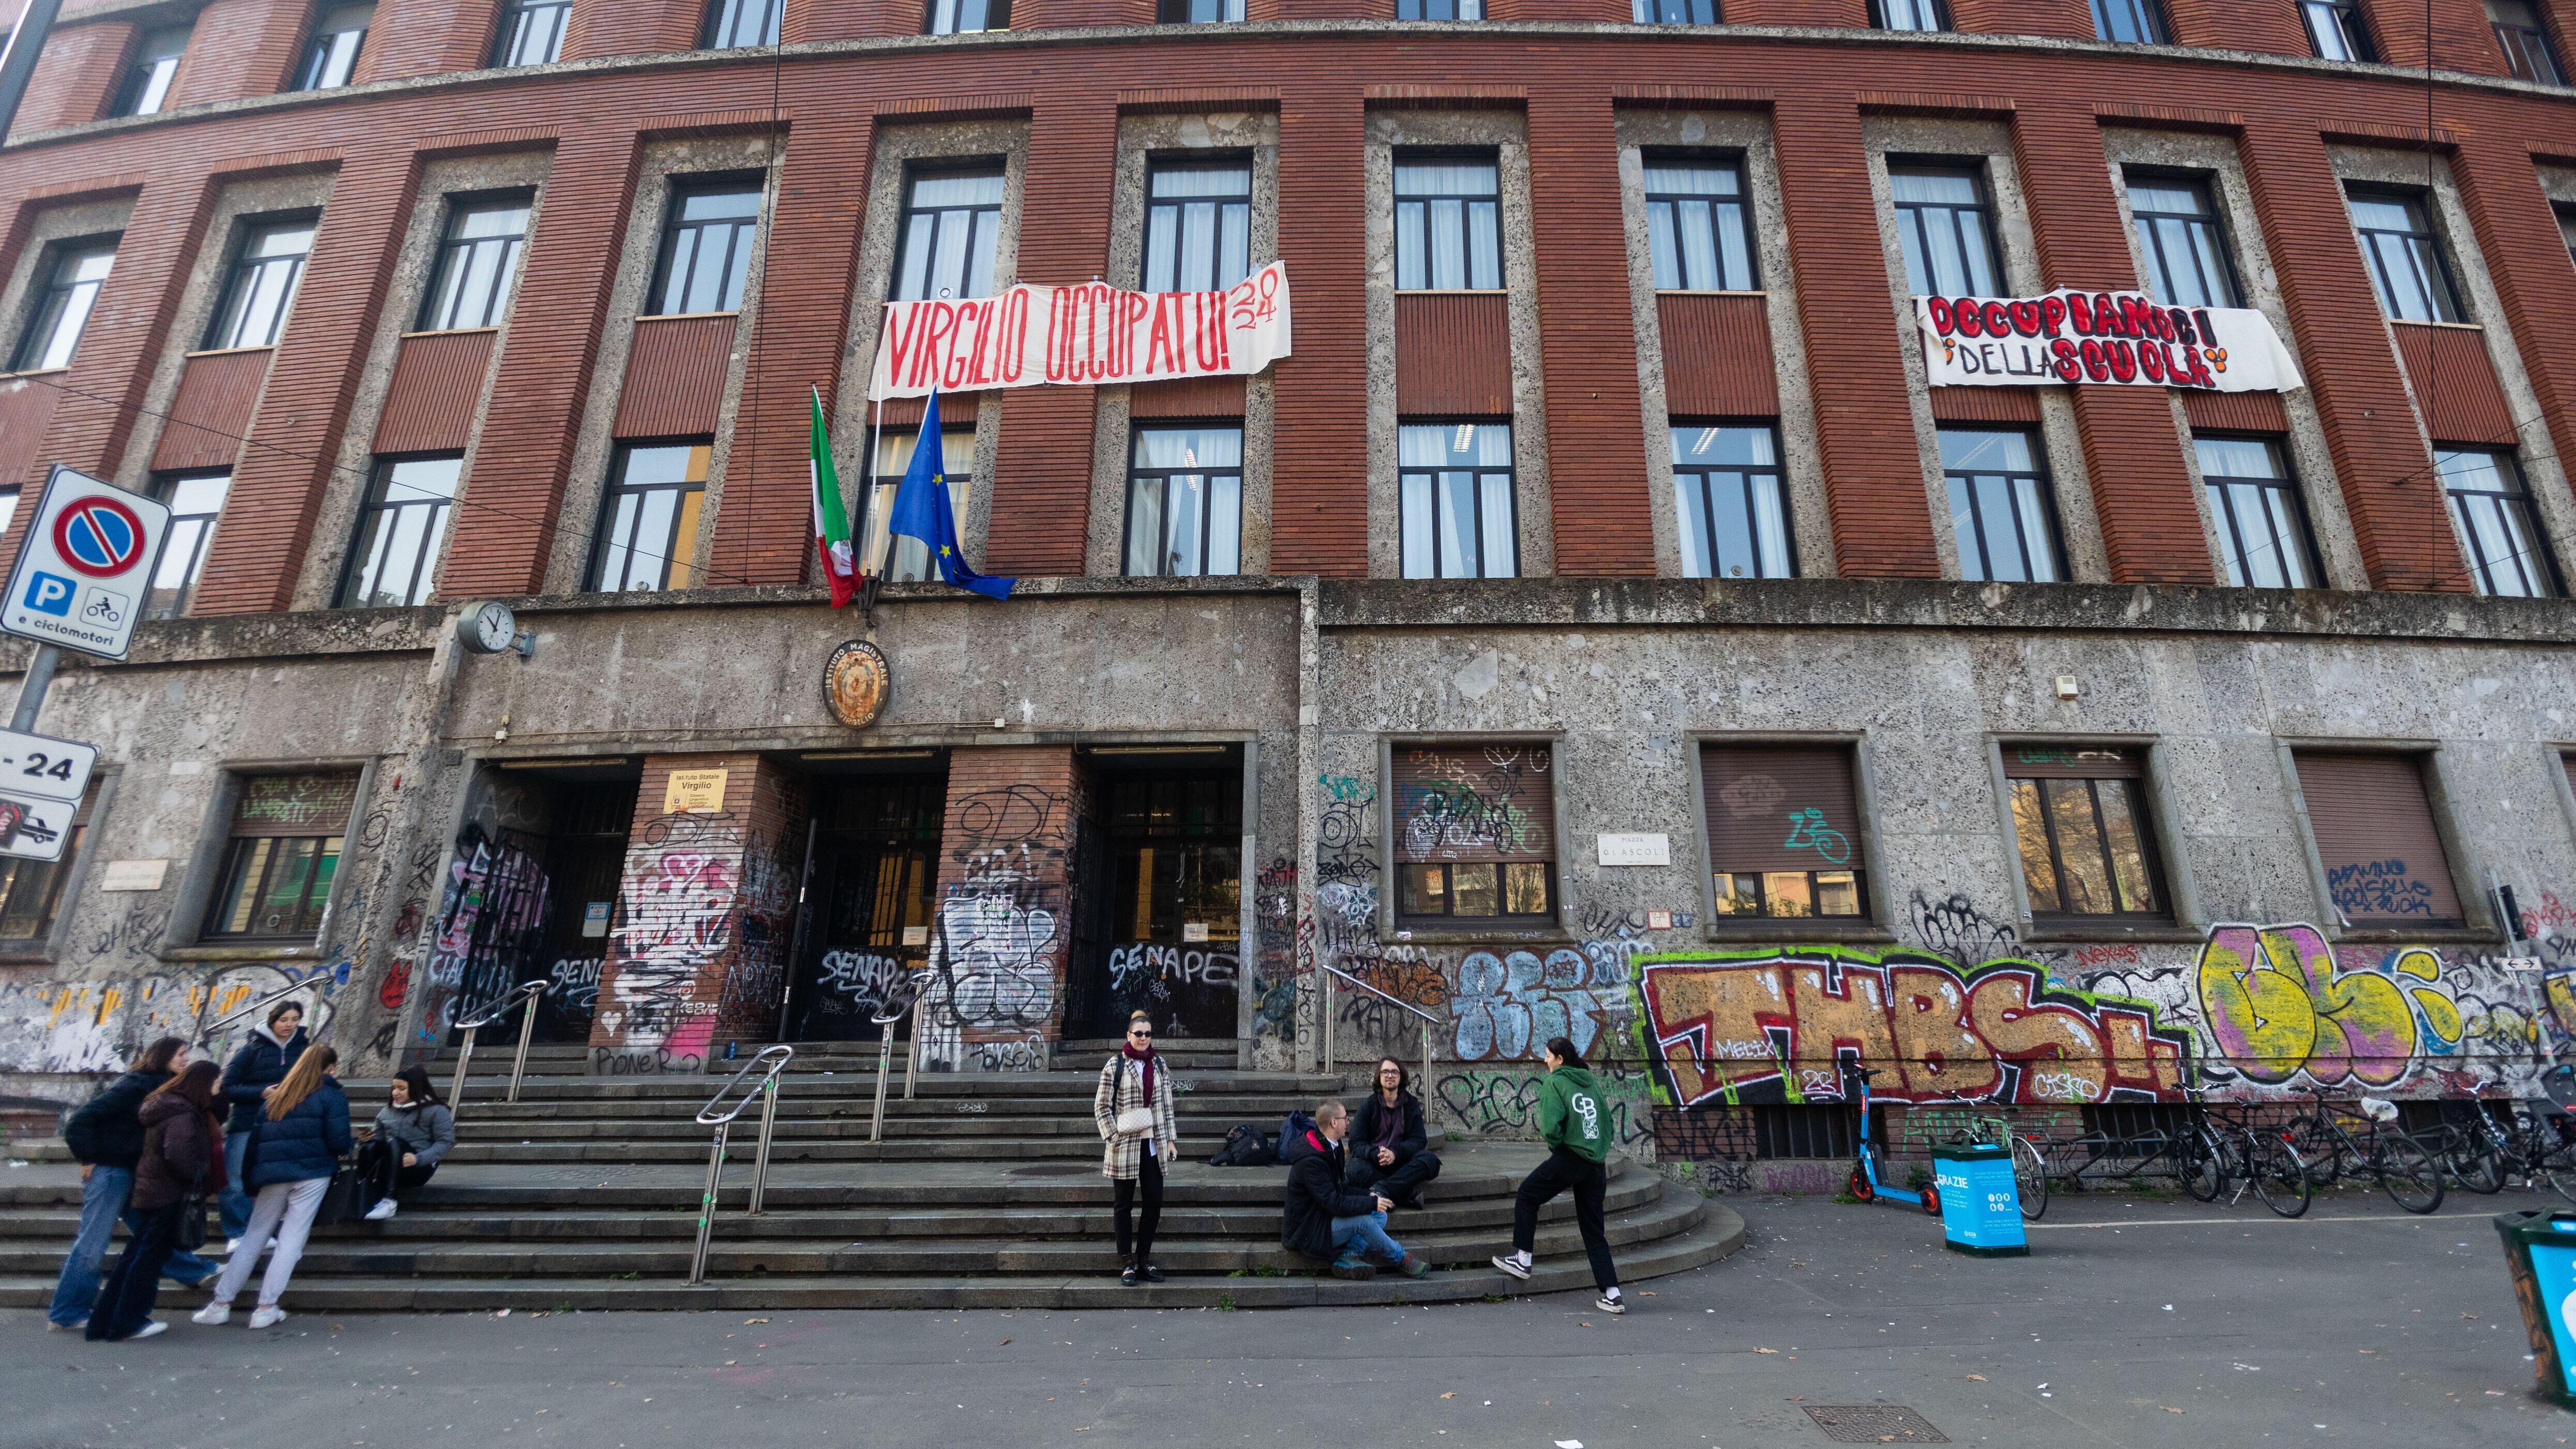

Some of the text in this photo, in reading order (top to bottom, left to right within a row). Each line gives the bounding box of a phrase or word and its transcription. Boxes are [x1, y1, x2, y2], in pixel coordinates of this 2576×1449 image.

[890, 288, 1028, 389] VIRGILIO
[1958, 337, 2216, 389] DELLA SCUOLA
[35, 577, 66, 607] P
[34, 619, 114, 646] ciclomotori
[825, 643, 889, 688] ISTITUTO MAGISTRALE
[838, 712, 874, 725] VIRGILIO
[23, 753, 73, 781] 24
[682, 781, 711, 791] Virgilio
[1109, 943, 1240, 990] SENAPE
[1937, 1173, 1969, 1189] GRAZIE
